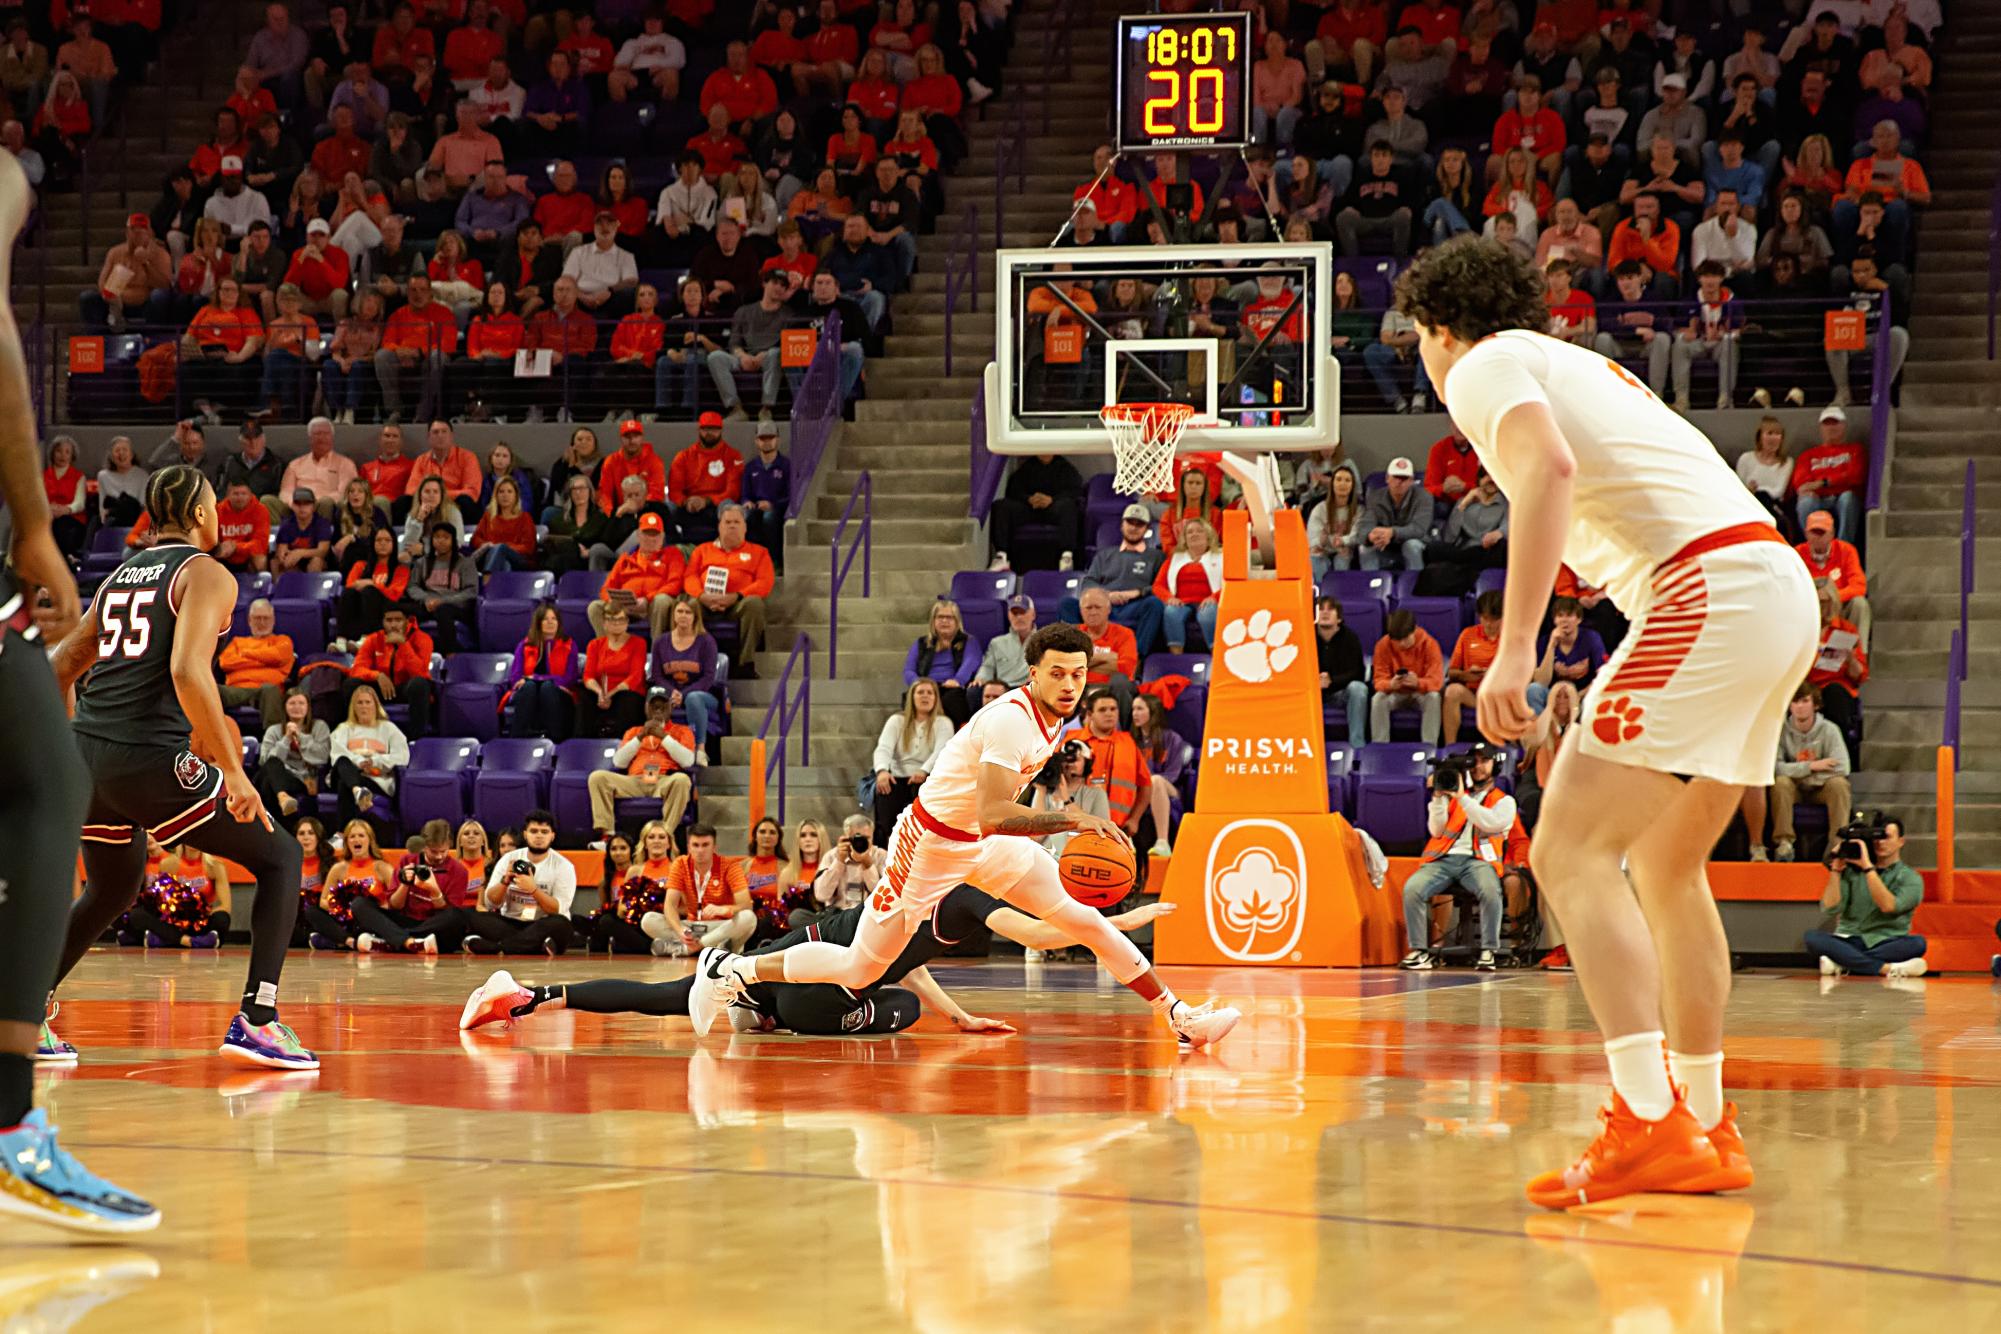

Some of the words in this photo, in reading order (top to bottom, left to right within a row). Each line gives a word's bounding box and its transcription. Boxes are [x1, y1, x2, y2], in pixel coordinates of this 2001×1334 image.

[1147, 26, 1236, 66] 18:07
[1144, 68, 1224, 135] 20
[1151, 136, 1215, 146] DAKTRONICS
[788, 343, 810, 357] 102
[1053, 339, 1073, 353] 101
[116, 563, 166, 584] COOPER
[99, 588, 159, 659] 55
[1207, 737, 1315, 759] PRISMA
[1225, 762, 1295, 775] HEALTH
[1070, 864, 1111, 881] ELITE
